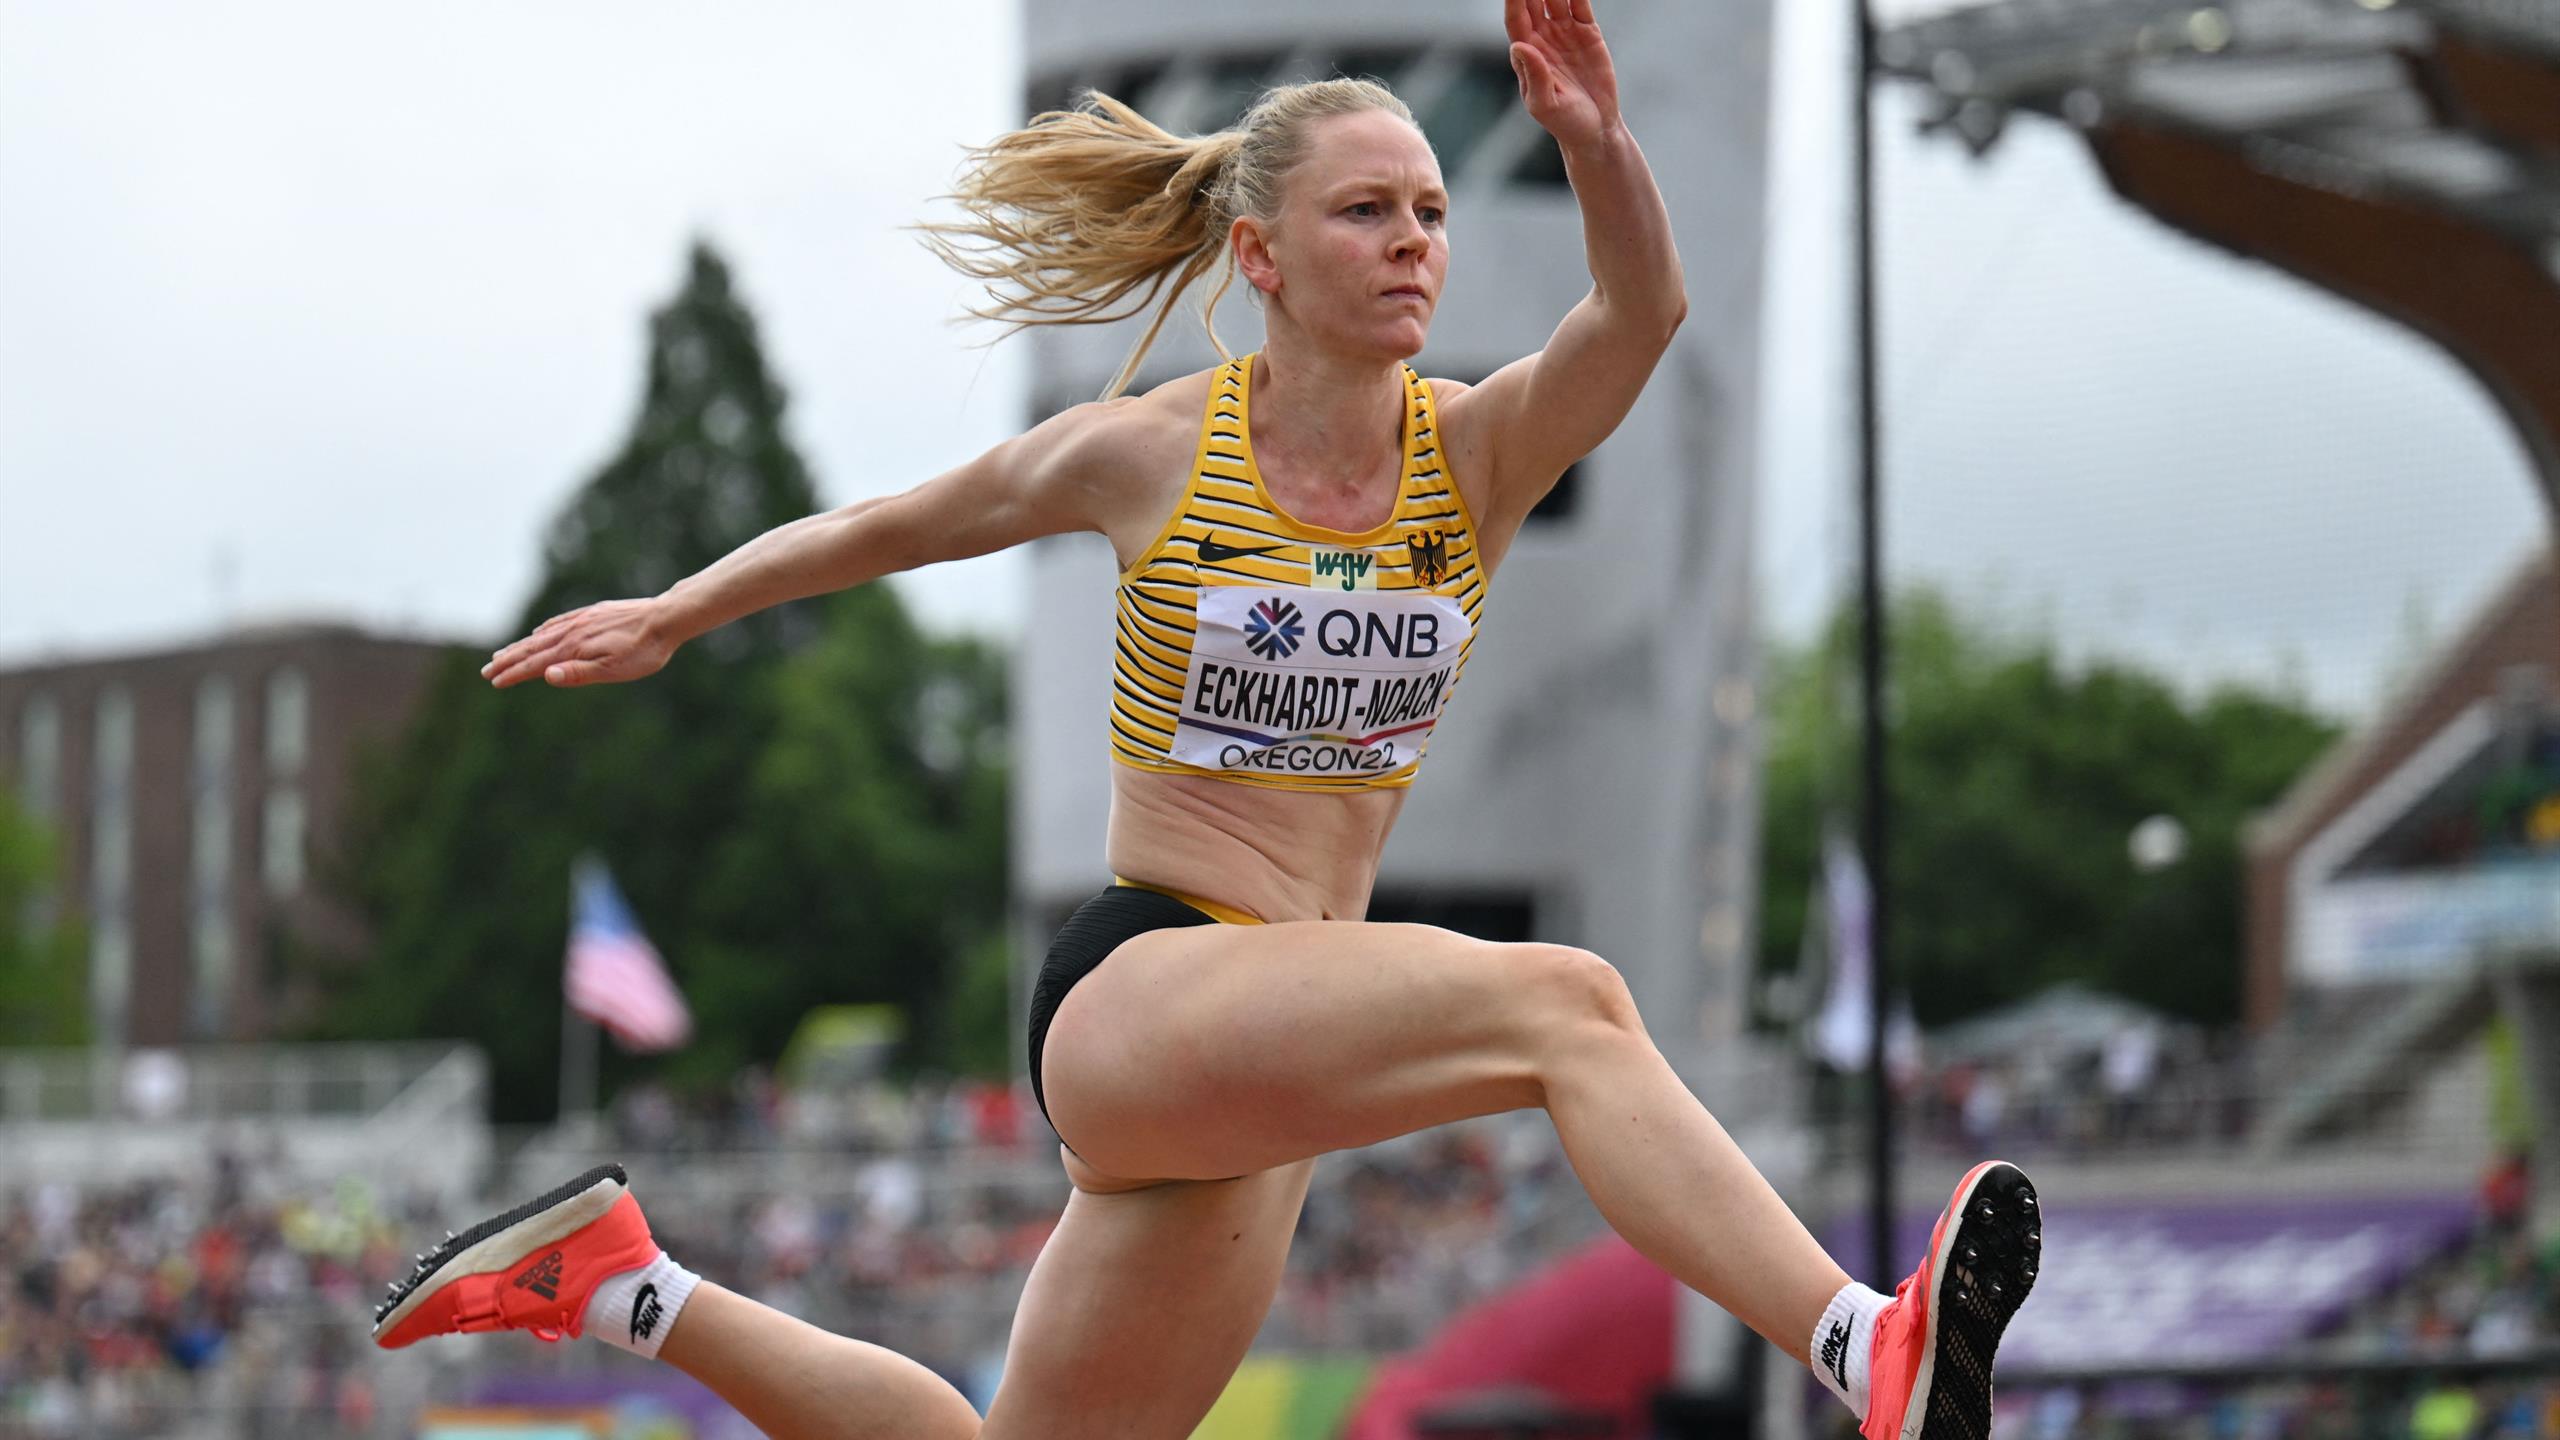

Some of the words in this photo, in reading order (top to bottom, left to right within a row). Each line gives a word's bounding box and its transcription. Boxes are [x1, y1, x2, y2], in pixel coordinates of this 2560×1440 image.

[1317, 609, 1439, 659] QNB
[1193, 662, 1452, 732] ECKHARDT-NOACK
[1219, 741, 1397, 772] OREGON22
[513, 1250, 562, 1289] adidas
[638, 1297, 664, 1340] NIKE
